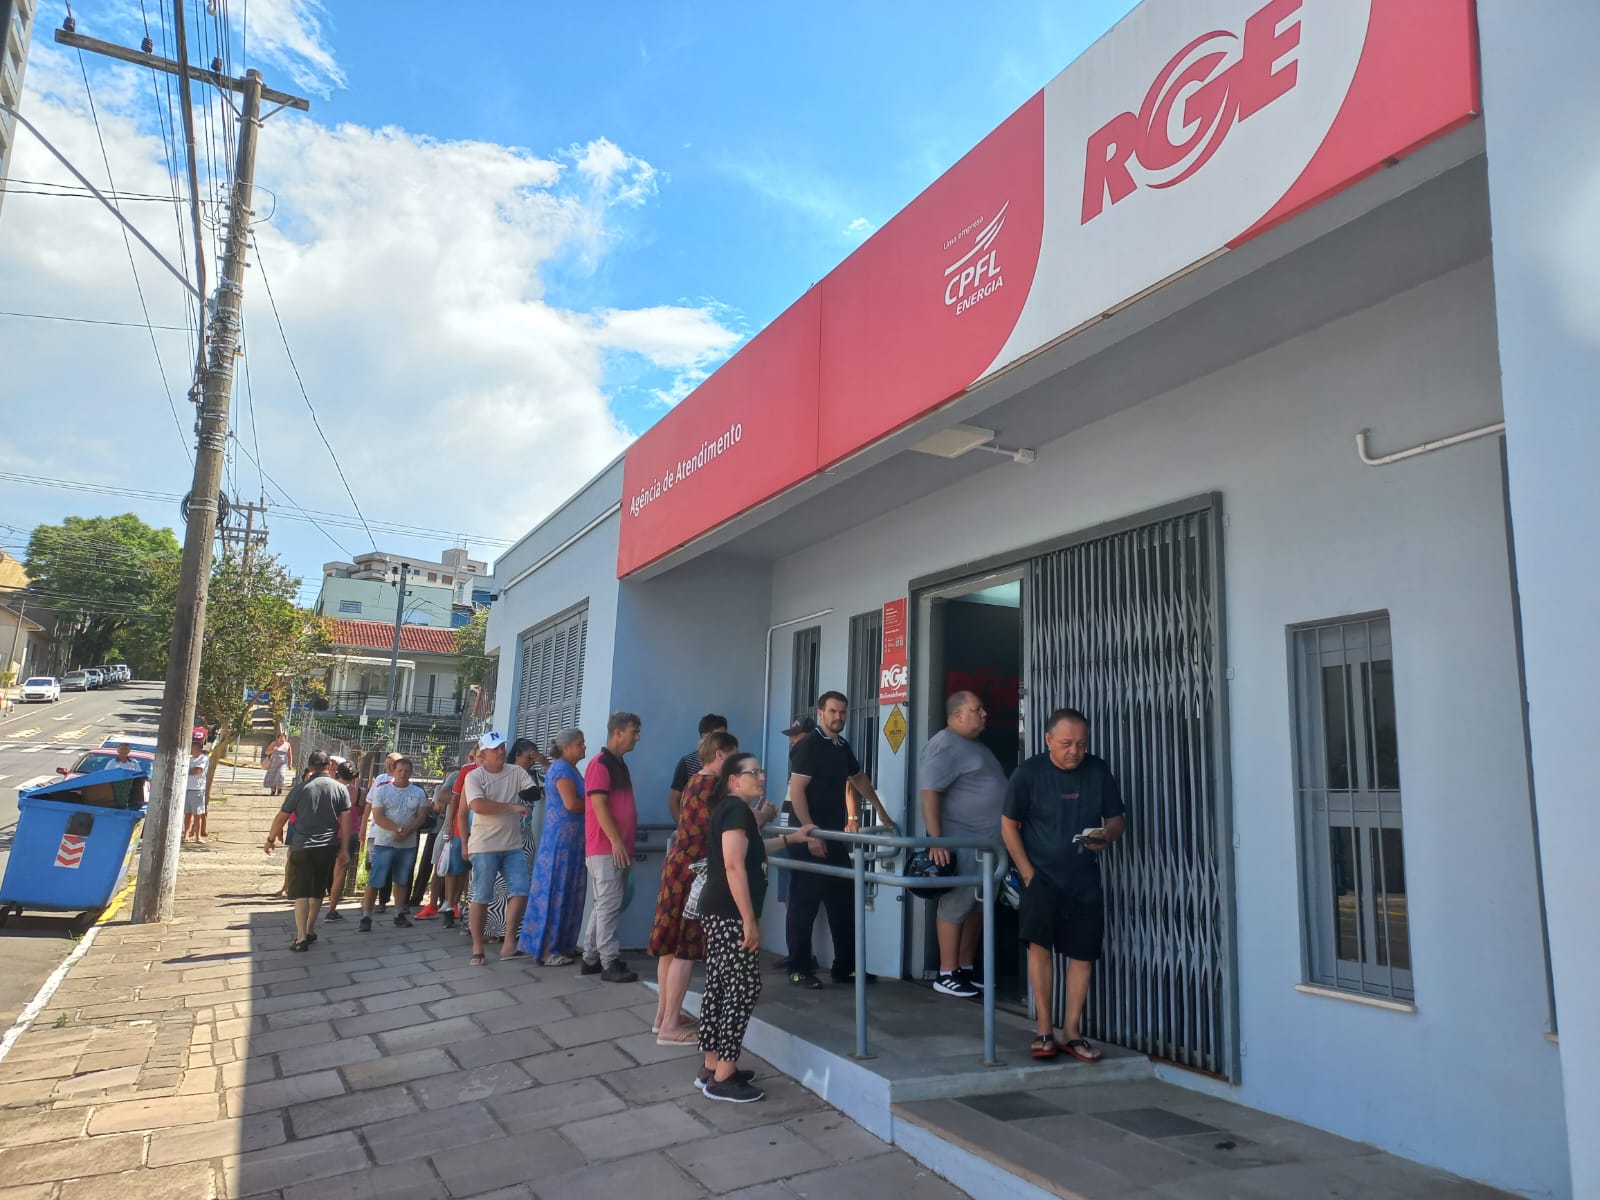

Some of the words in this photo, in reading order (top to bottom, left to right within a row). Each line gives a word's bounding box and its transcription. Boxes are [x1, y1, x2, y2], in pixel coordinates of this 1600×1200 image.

[1081, 0, 1302, 226] RGE
[943, 236, 957, 250] Uma
[958, 216, 984, 240] empresa
[945, 249, 1001, 306] CPFL
[956, 275, 1003, 315] ENERGIA
[630, 479, 661, 517] Agência
[662, 470, 674, 492] de
[675, 423, 742, 483] Atendimento
[490, 732, 500, 741] N
